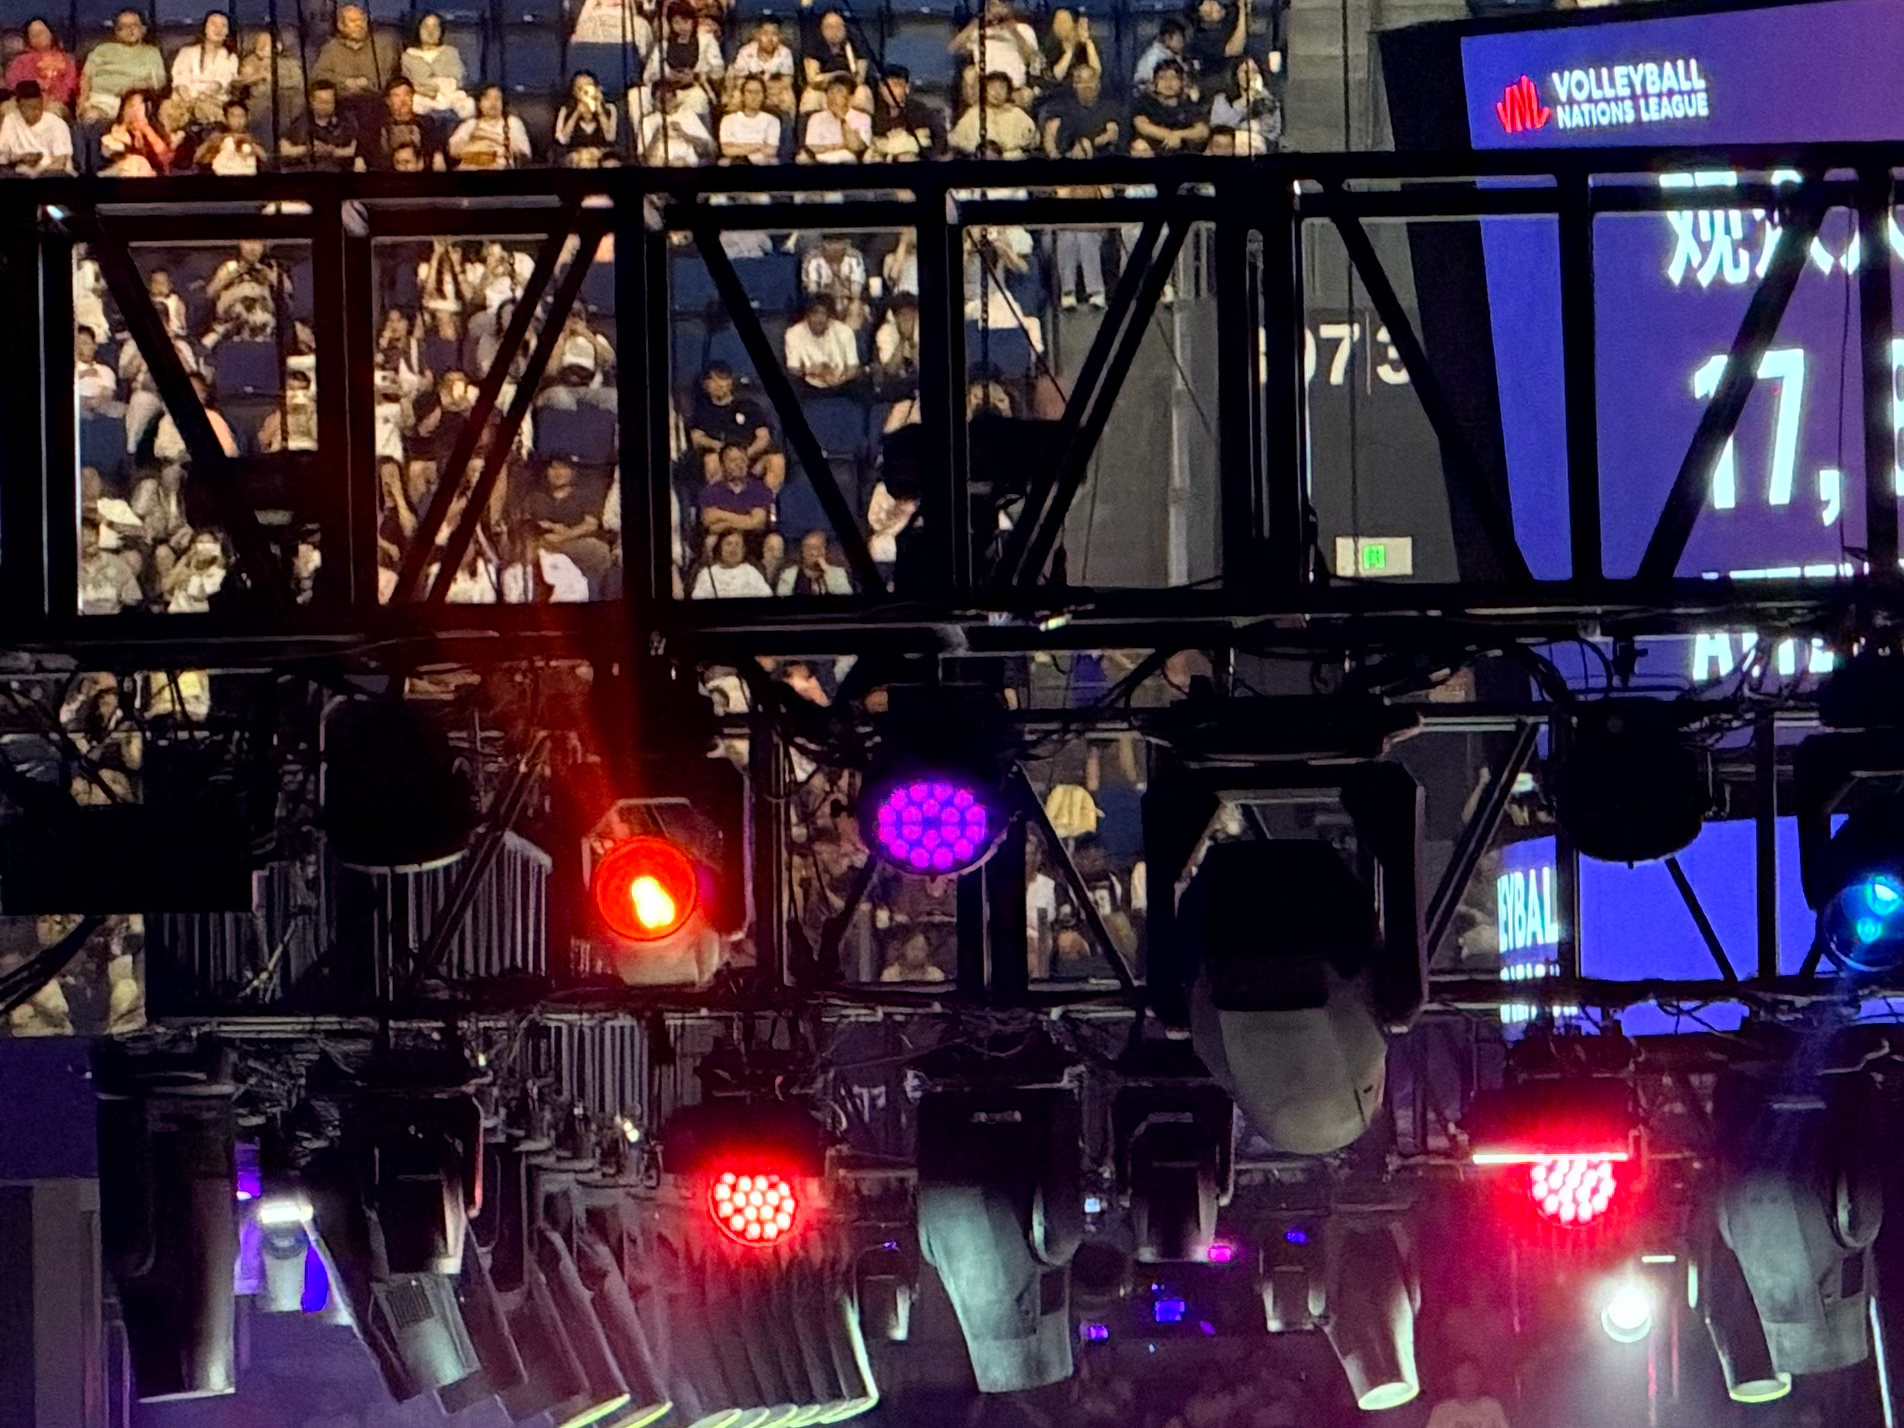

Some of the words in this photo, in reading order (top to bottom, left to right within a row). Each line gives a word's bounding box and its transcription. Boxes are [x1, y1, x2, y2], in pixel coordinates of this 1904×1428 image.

[1552, 58, 1707, 103] VOLLEYBALL
[1556, 98, 1636, 129] NATIONS
[1640, 92, 1709, 122] LEAGUE
